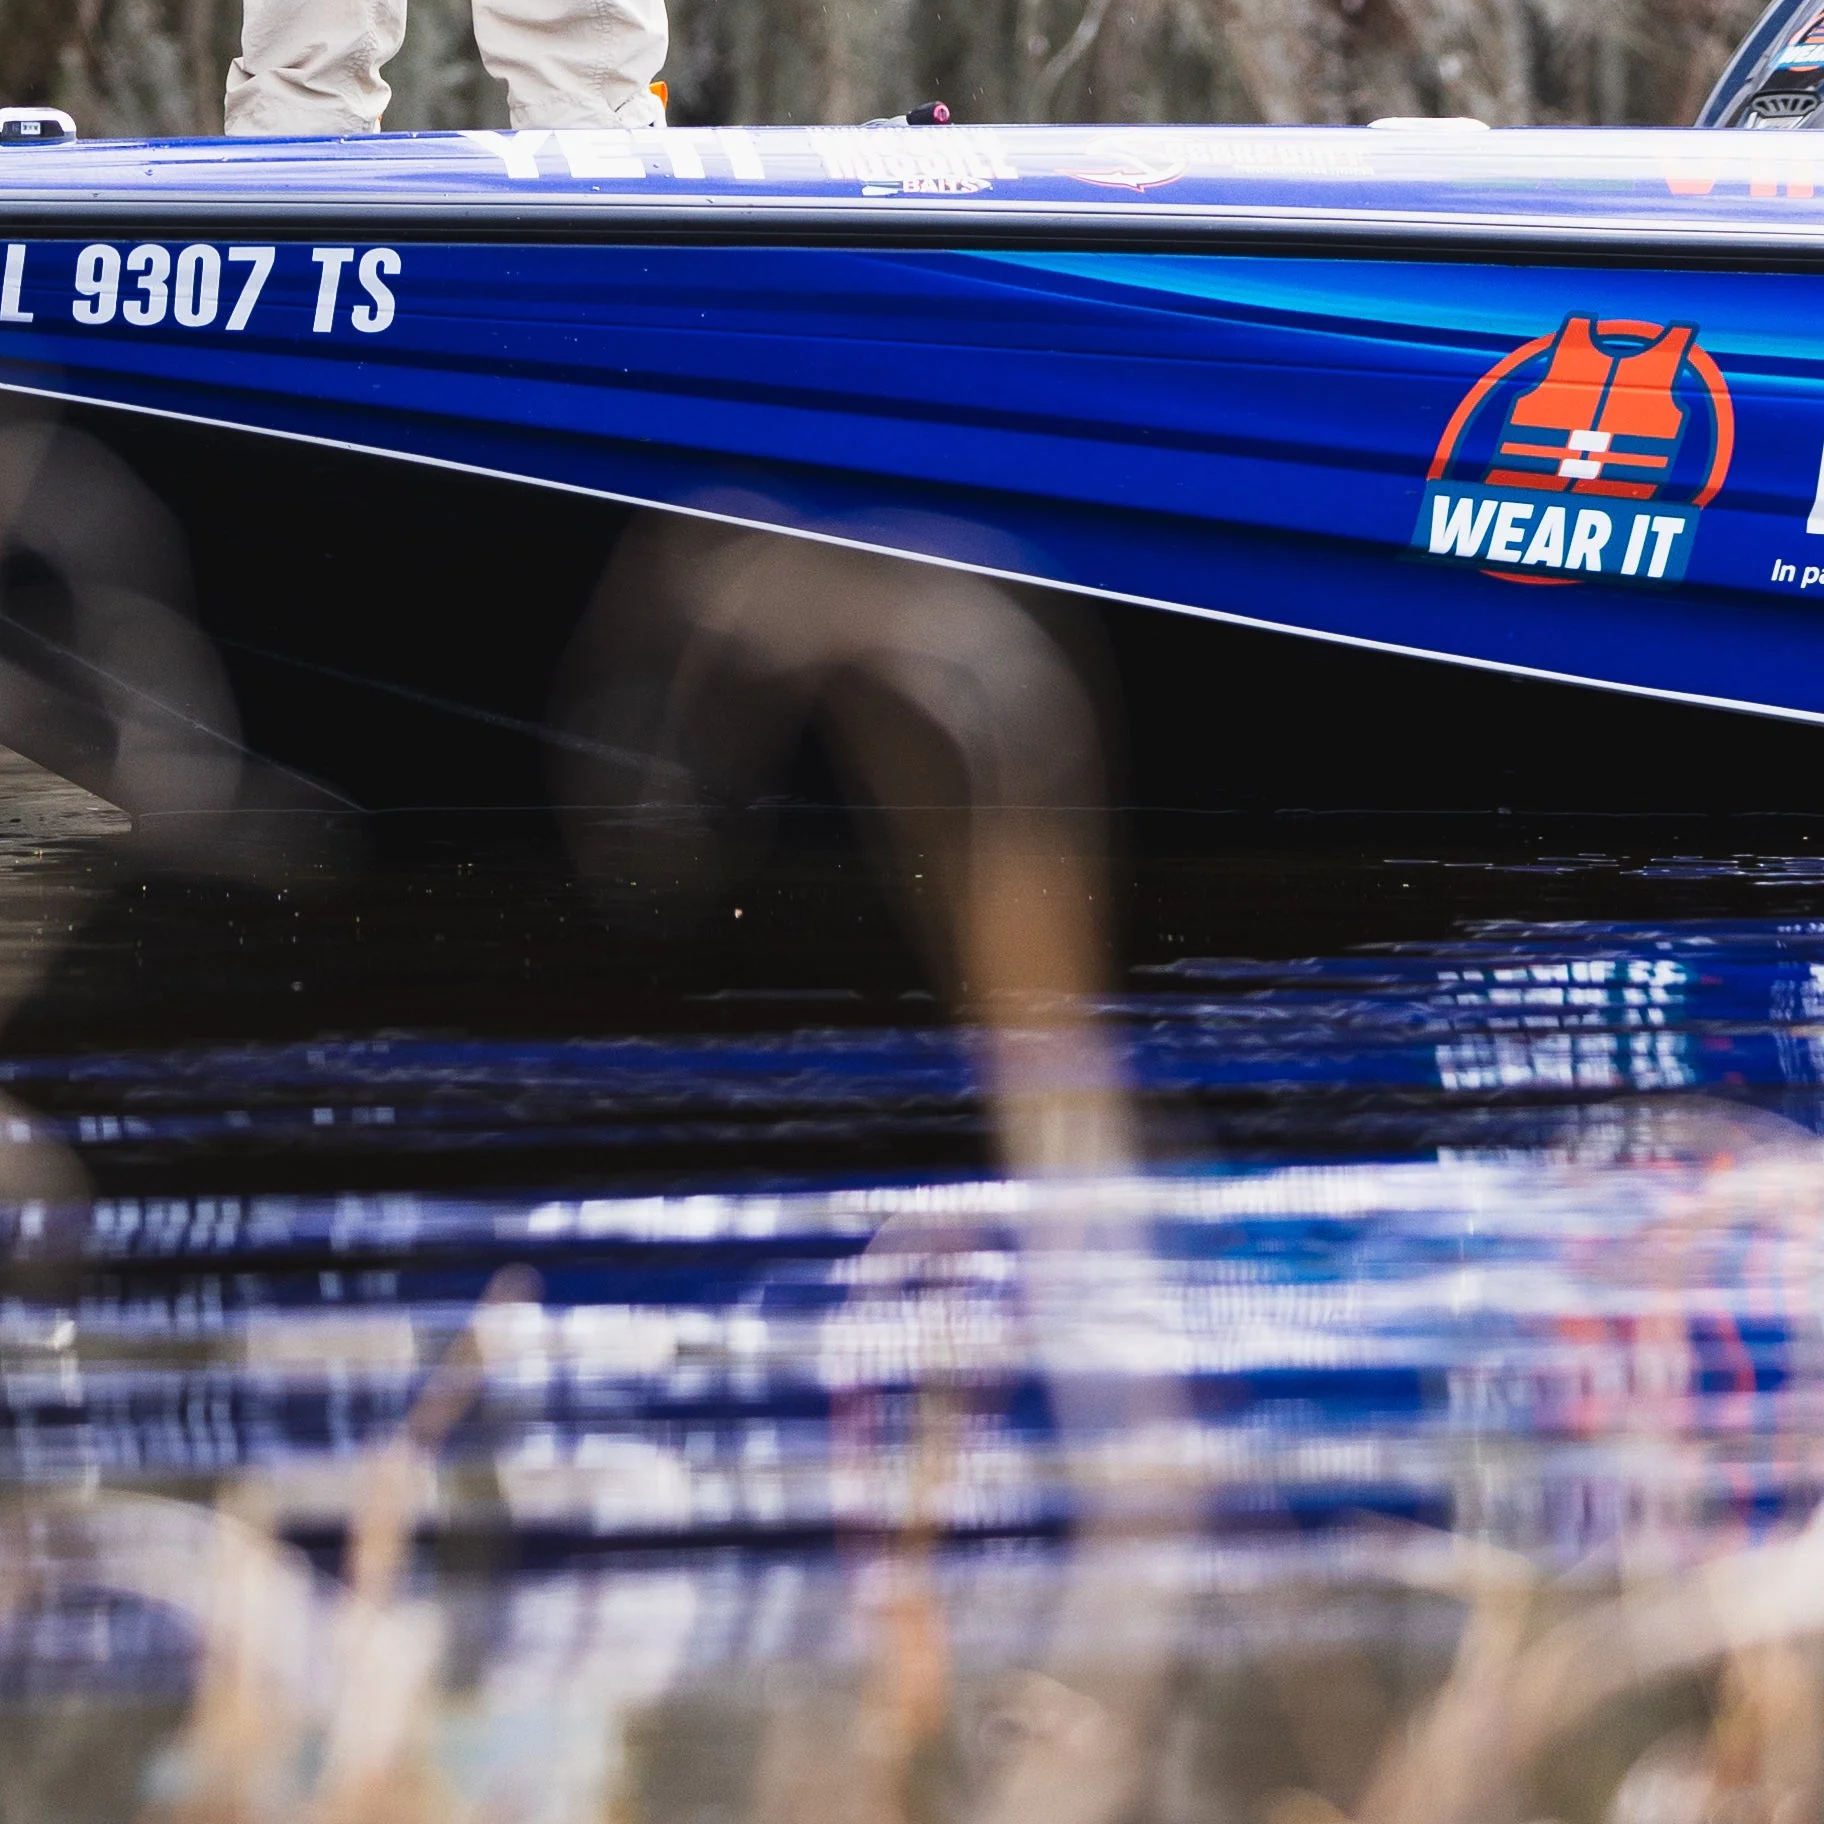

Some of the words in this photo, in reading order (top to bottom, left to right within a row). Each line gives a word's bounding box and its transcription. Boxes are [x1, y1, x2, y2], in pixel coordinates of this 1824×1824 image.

[458, 129, 767, 180] YETI
[902, 177, 980, 194] BAITS
[72, 244, 276, 331] 9307
[312, 247, 402, 334] TS
[1428, 494, 1613, 572] WEAR
[1620, 514, 1686, 579] IT
[1770, 558, 1797, 583] In
